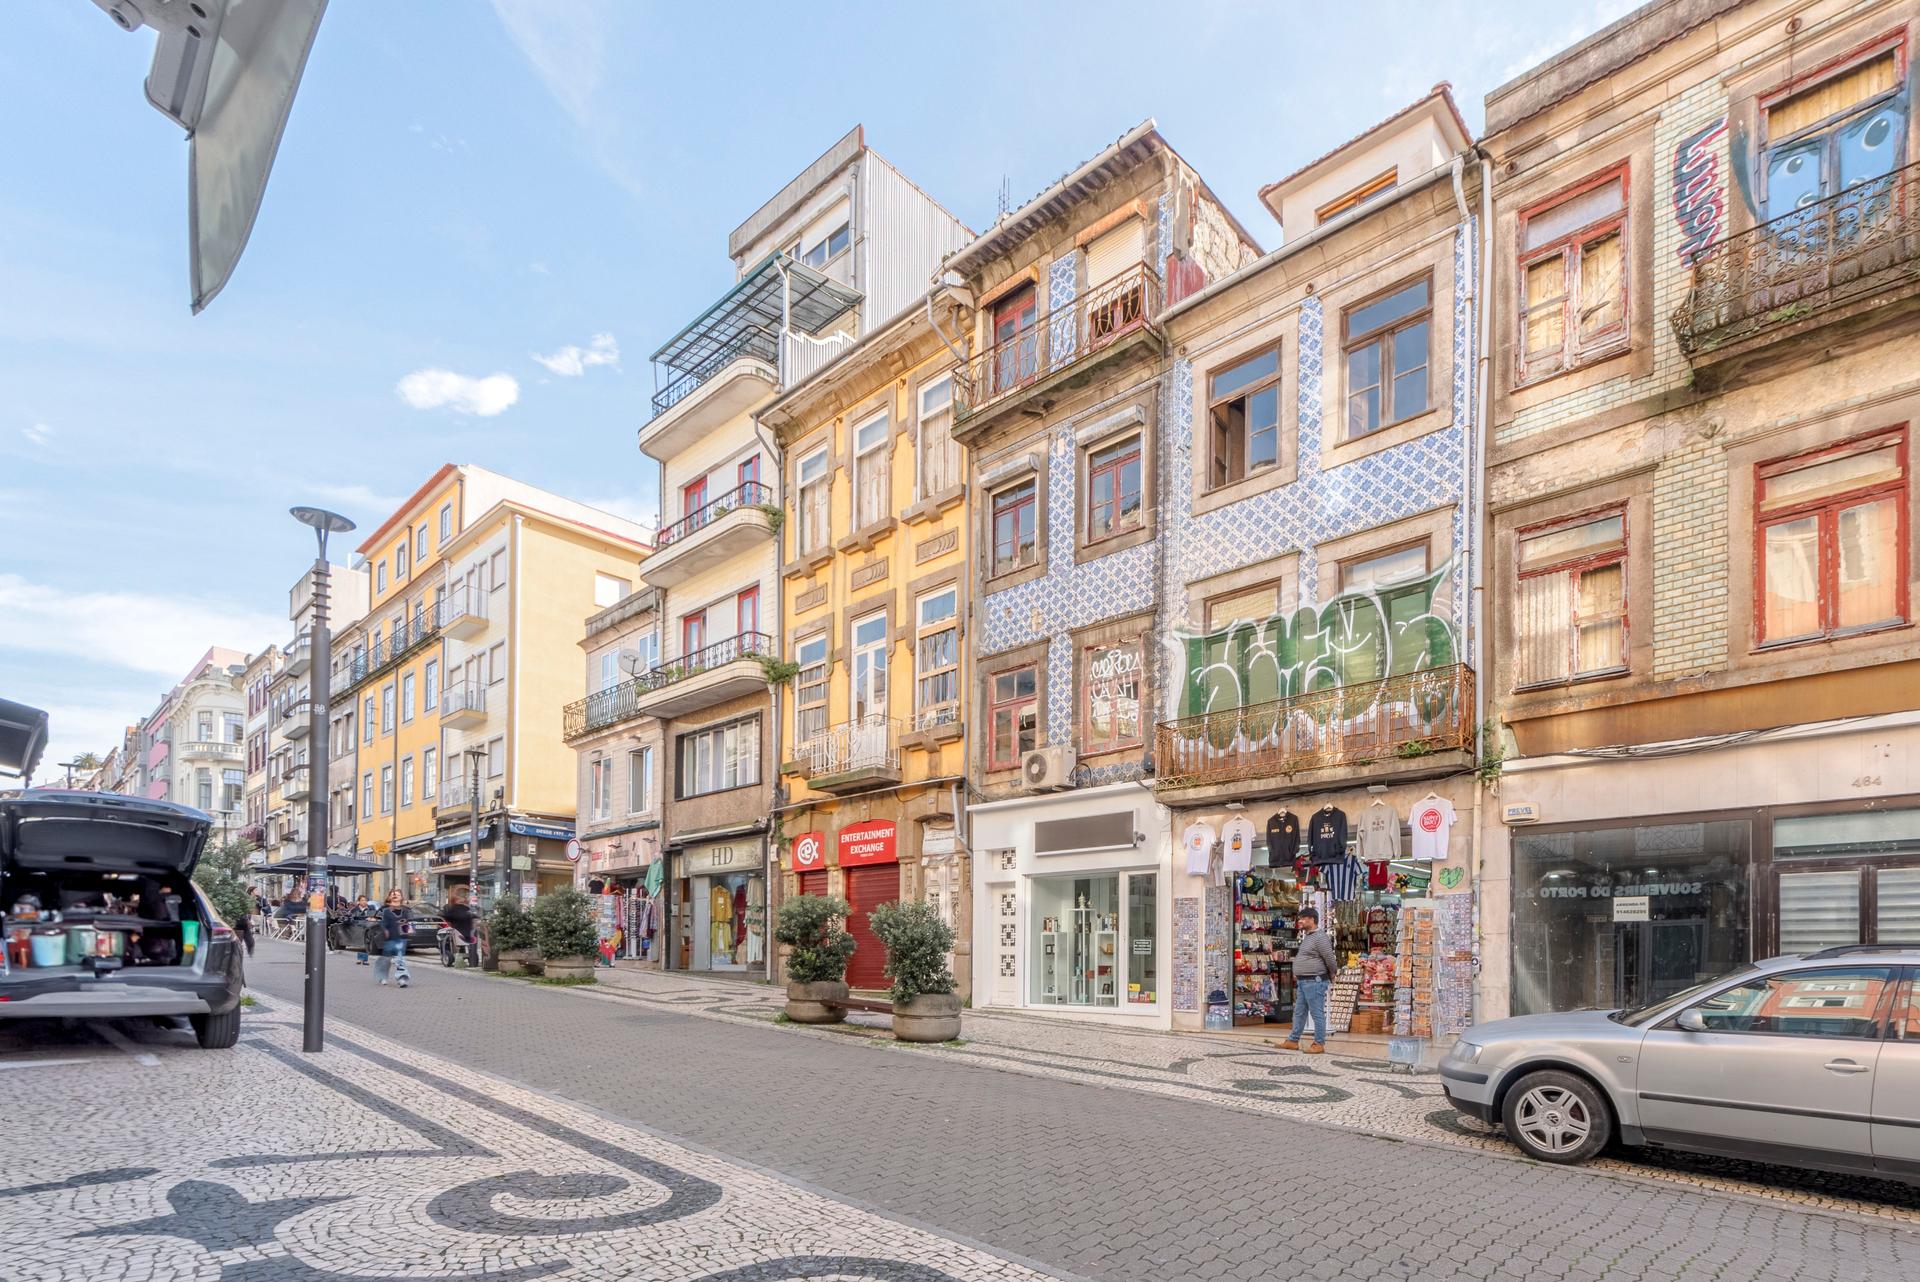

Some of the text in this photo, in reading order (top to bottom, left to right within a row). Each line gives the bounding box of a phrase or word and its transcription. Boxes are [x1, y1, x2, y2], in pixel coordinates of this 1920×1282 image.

[841, 827, 895, 843] ENTERTAINMENT
[711, 846, 734, 866] HD
[850, 842, 885, 855] EXCHANGE
[1304, 866, 1310, 883] 7
[1374, 862, 1381, 875] 7
